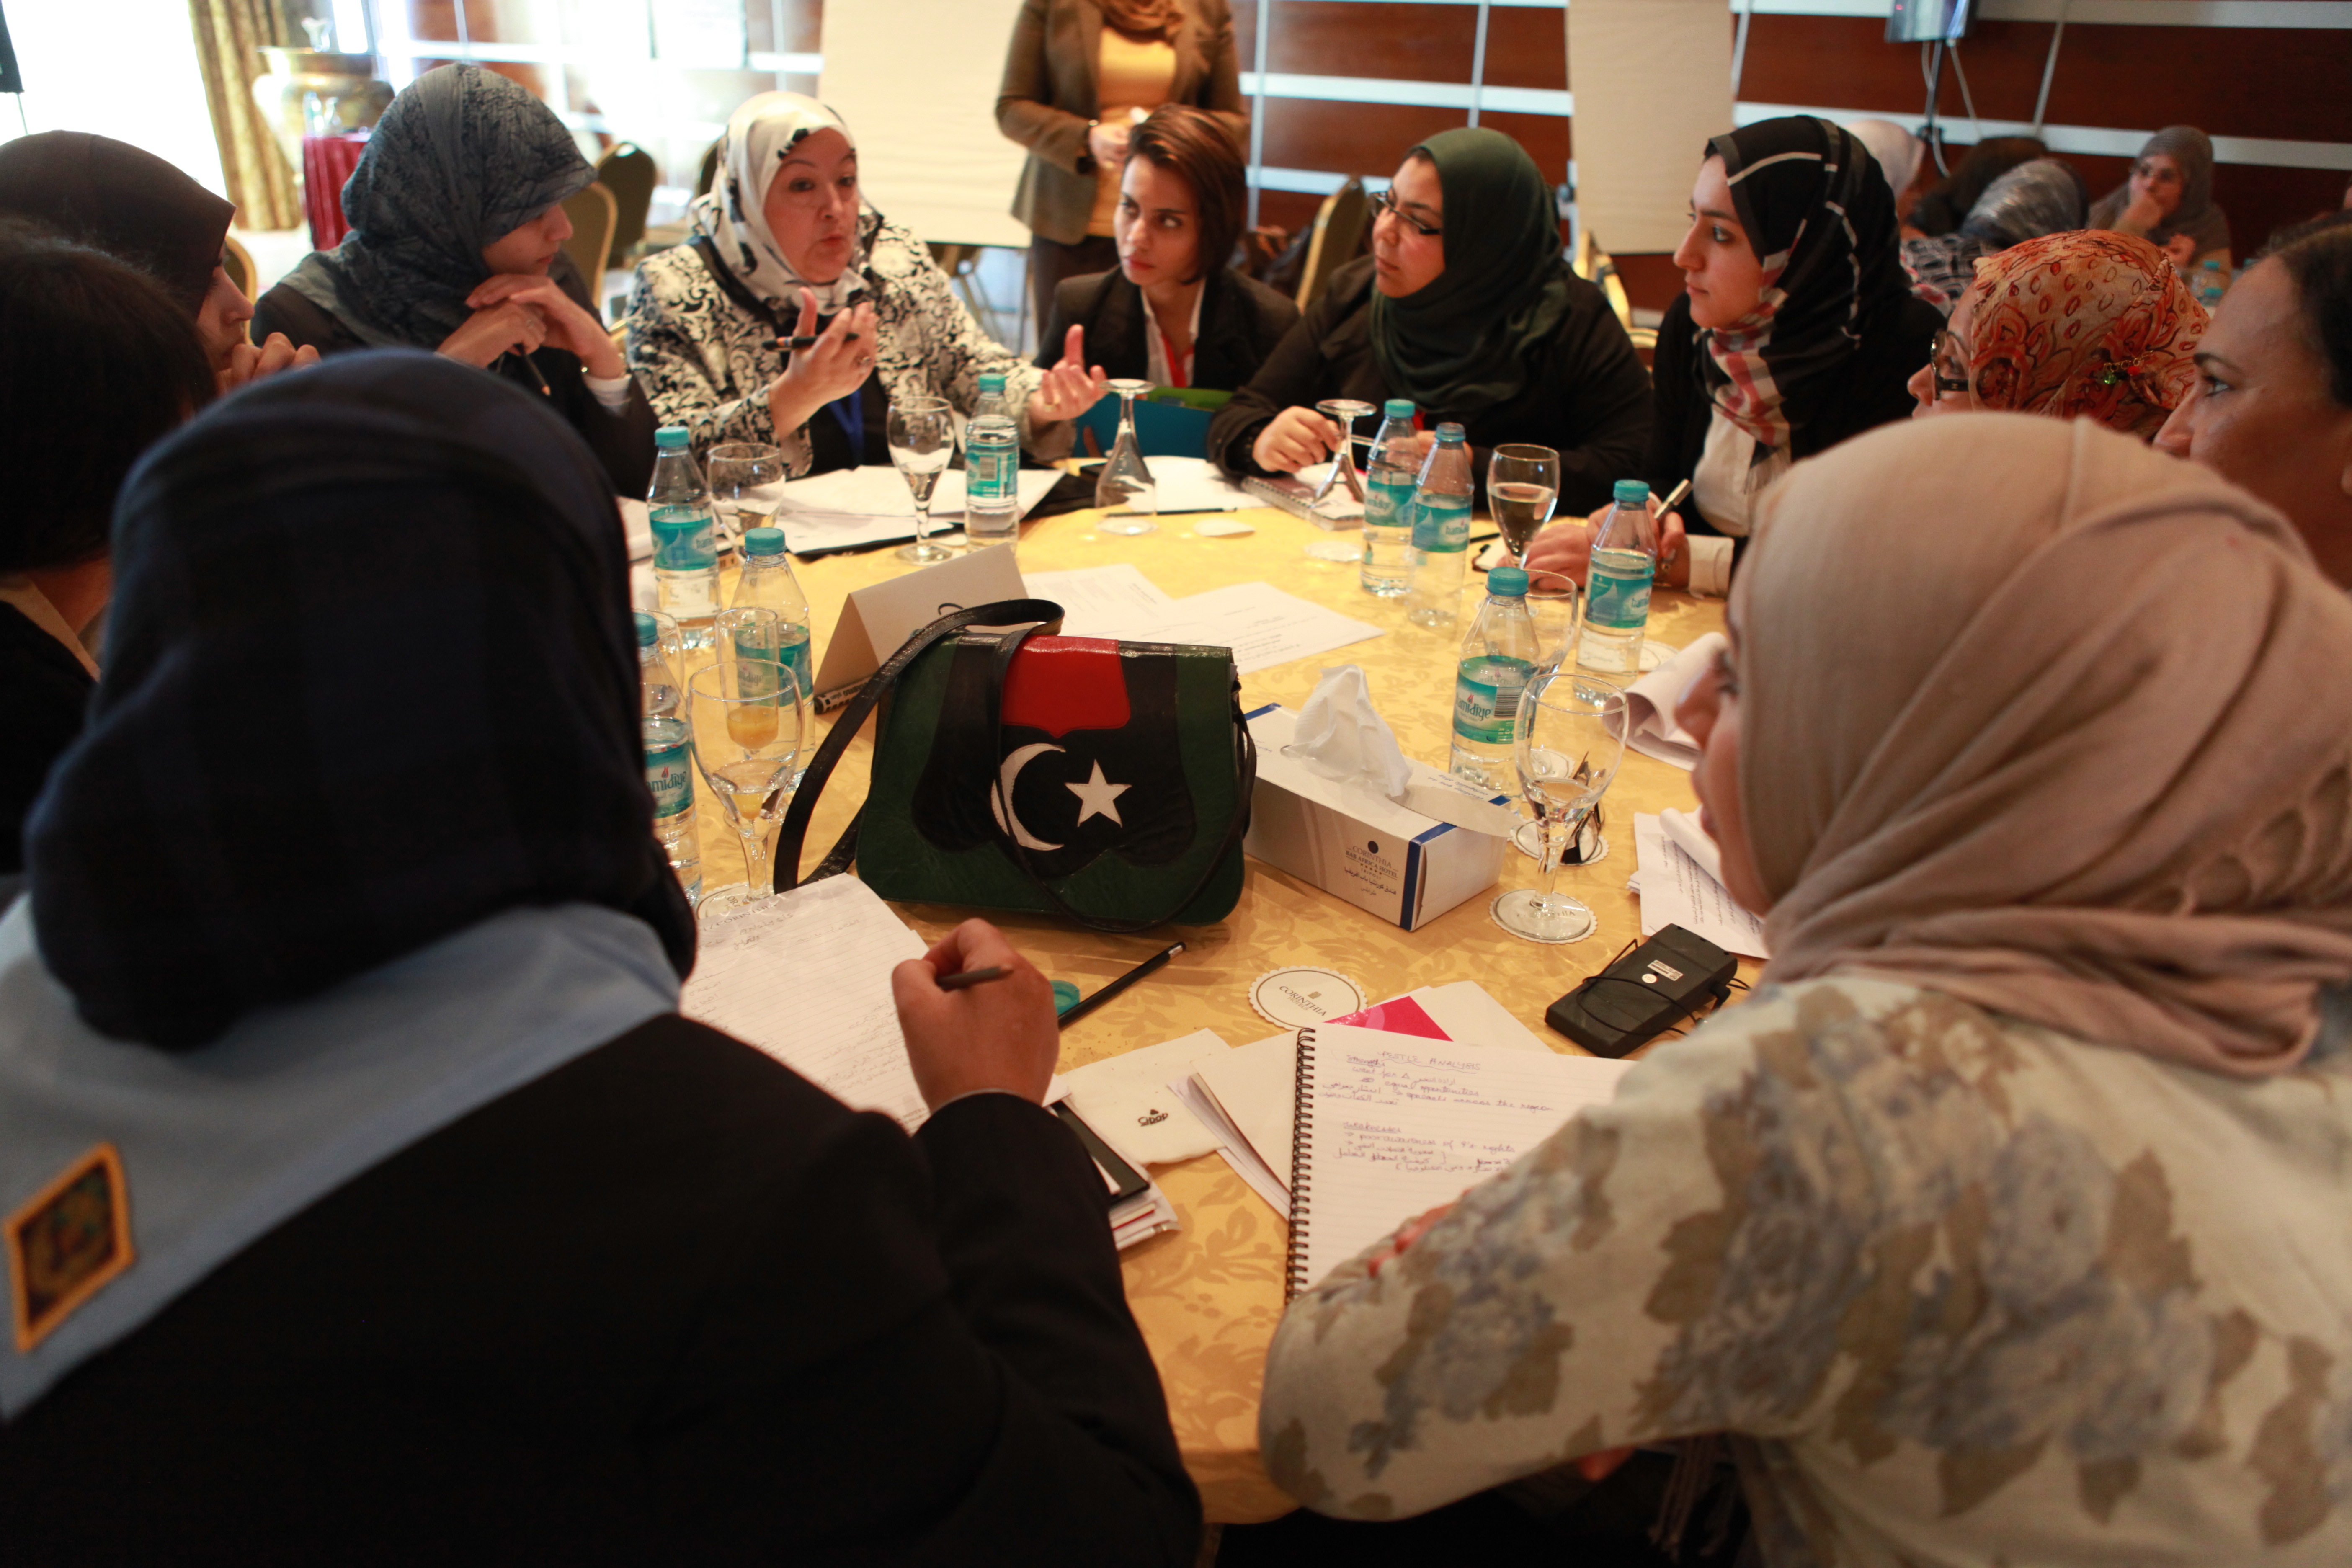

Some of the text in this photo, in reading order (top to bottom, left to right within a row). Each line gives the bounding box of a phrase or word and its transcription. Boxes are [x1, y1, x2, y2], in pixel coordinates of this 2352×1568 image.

[1346, 850, 1398, 878] BAB AFRICA HOTEL
[1352, 846, 1392, 869] CORINTHIA
[1361, 868, 1382, 880] TRIPOLI
[1279, 985, 1327, 1016] CORINTHIA
[1287, 996, 1310, 1011] HOTELS
[1429, 1058, 1481, 1070] ANALYSIS
